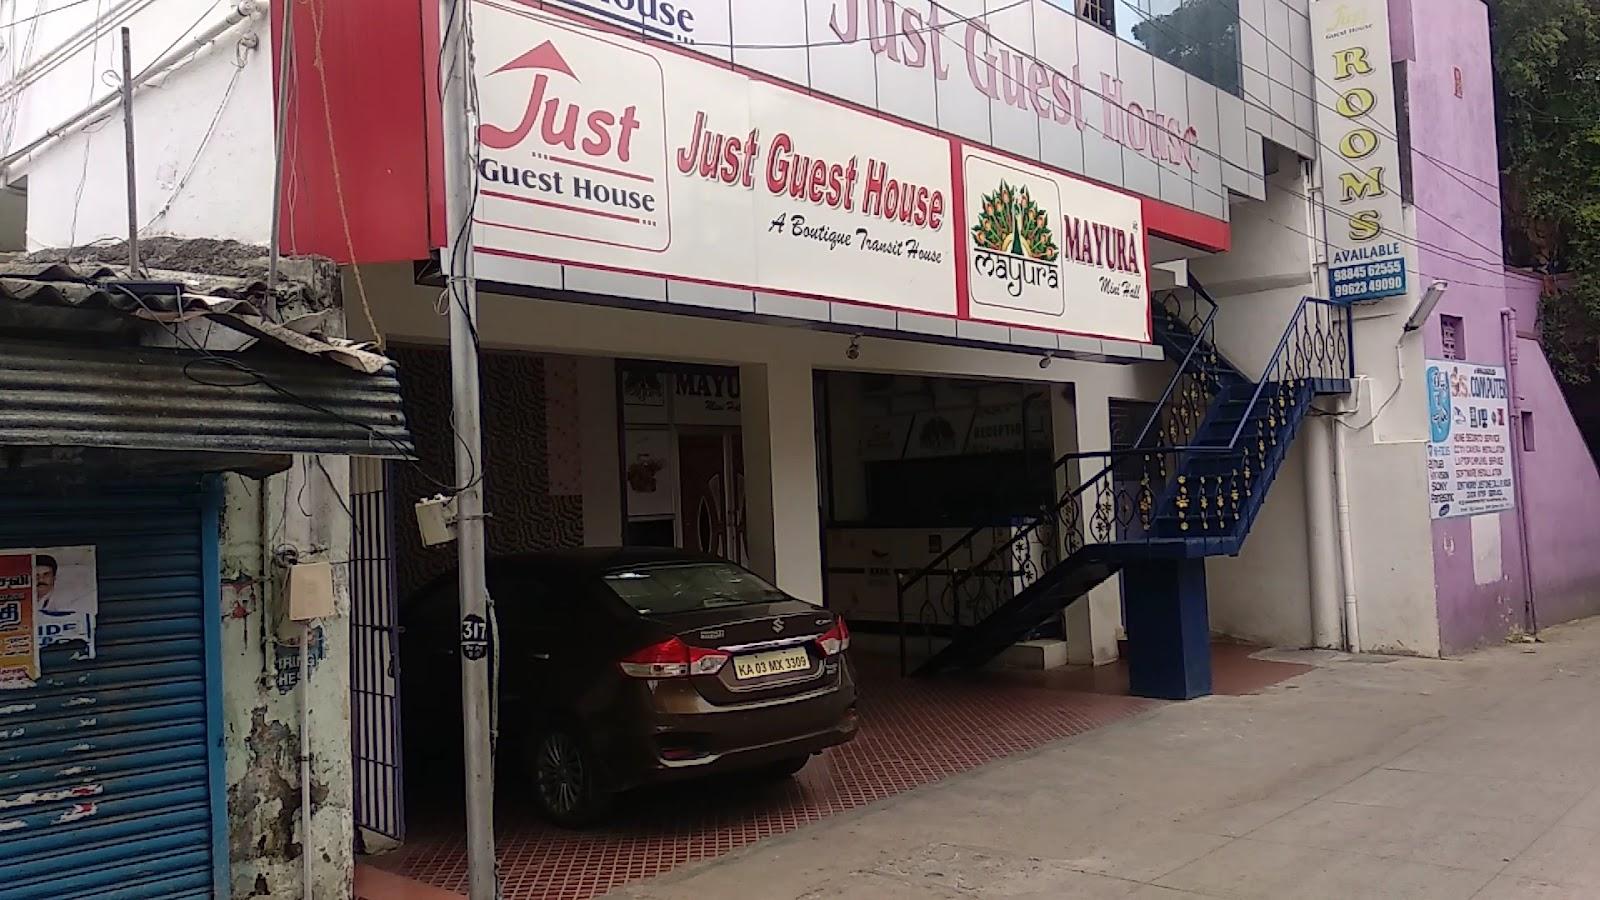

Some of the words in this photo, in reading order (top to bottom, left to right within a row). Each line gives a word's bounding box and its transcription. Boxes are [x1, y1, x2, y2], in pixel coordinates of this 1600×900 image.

[829, 0, 950, 80] Just
[965, 17, 1087, 132] Guest
[1100, 72, 1200, 174] House
[478, 74, 640, 162] Just
[480, 158, 563, 194] Guest
[573, 176, 655, 211] House
[677, 111, 760, 188] Just
[765, 132, 857, 211] Guest
[861, 158, 945, 230] House
[768, 211, 786, 233] A
[791, 214, 851, 250] Boutique
[855, 227, 902, 256] Transit
[906, 239, 942, 263] House
[1063, 214, 1140, 274] MAYURA
[1333, 243, 1401, 265] AVAILABLE
[973, 249, 1059, 297] mayura
[1098, 276, 1120, 295] Mini
[1122, 281, 1140, 299] Hall
[1334, 266, 1367, 282] 98845
[1369, 263, 1402, 278] 62555
[1335, 283, 1368, 299] 99623
[1369, 279, 1402, 293] 49090
[1431, 481, 1447, 490] SONY
[463, 620, 485, 640] 317
[738, 661, 754, 677] KA
[755, 659, 767, 673] 03
[768, 656, 785, 672] MX
[786, 652, 806, 669] 3309
